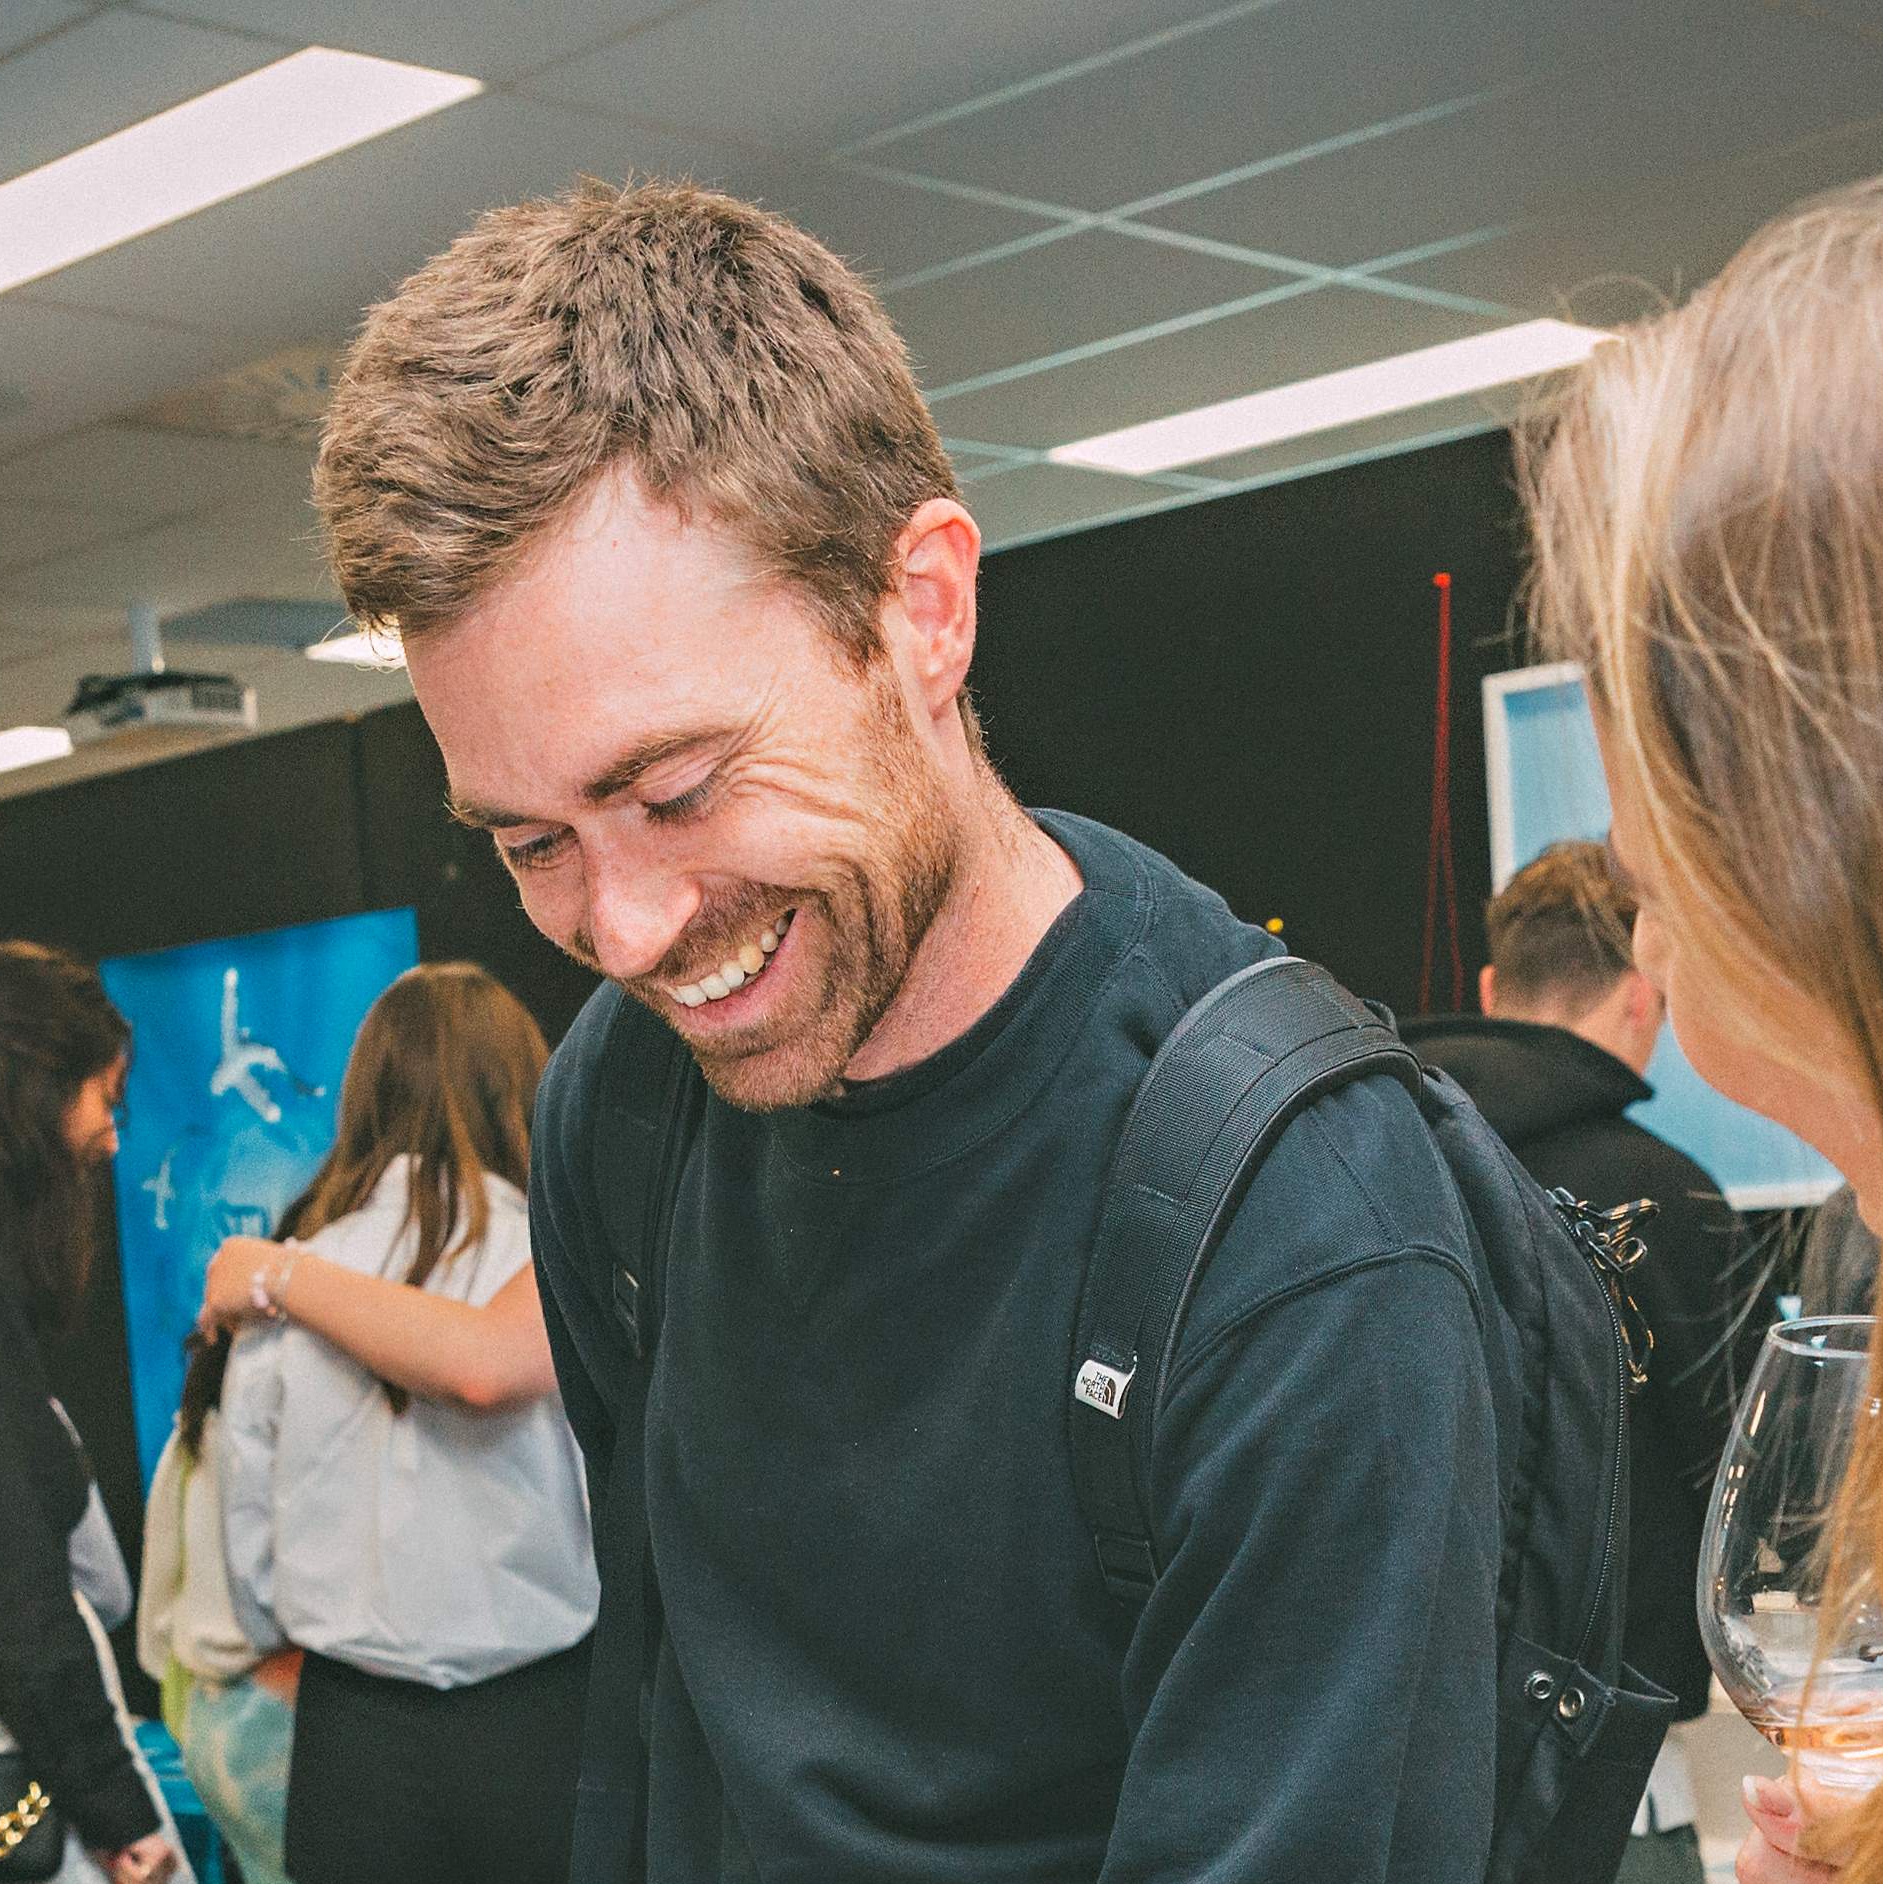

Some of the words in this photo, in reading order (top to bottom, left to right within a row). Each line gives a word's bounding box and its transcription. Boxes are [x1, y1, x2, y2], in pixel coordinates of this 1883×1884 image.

[1081, 1376, 1106, 1393] NORTH
[1095, 1372, 1108, 1384] THE
[1085, 1386, 1103, 1402] FACE
